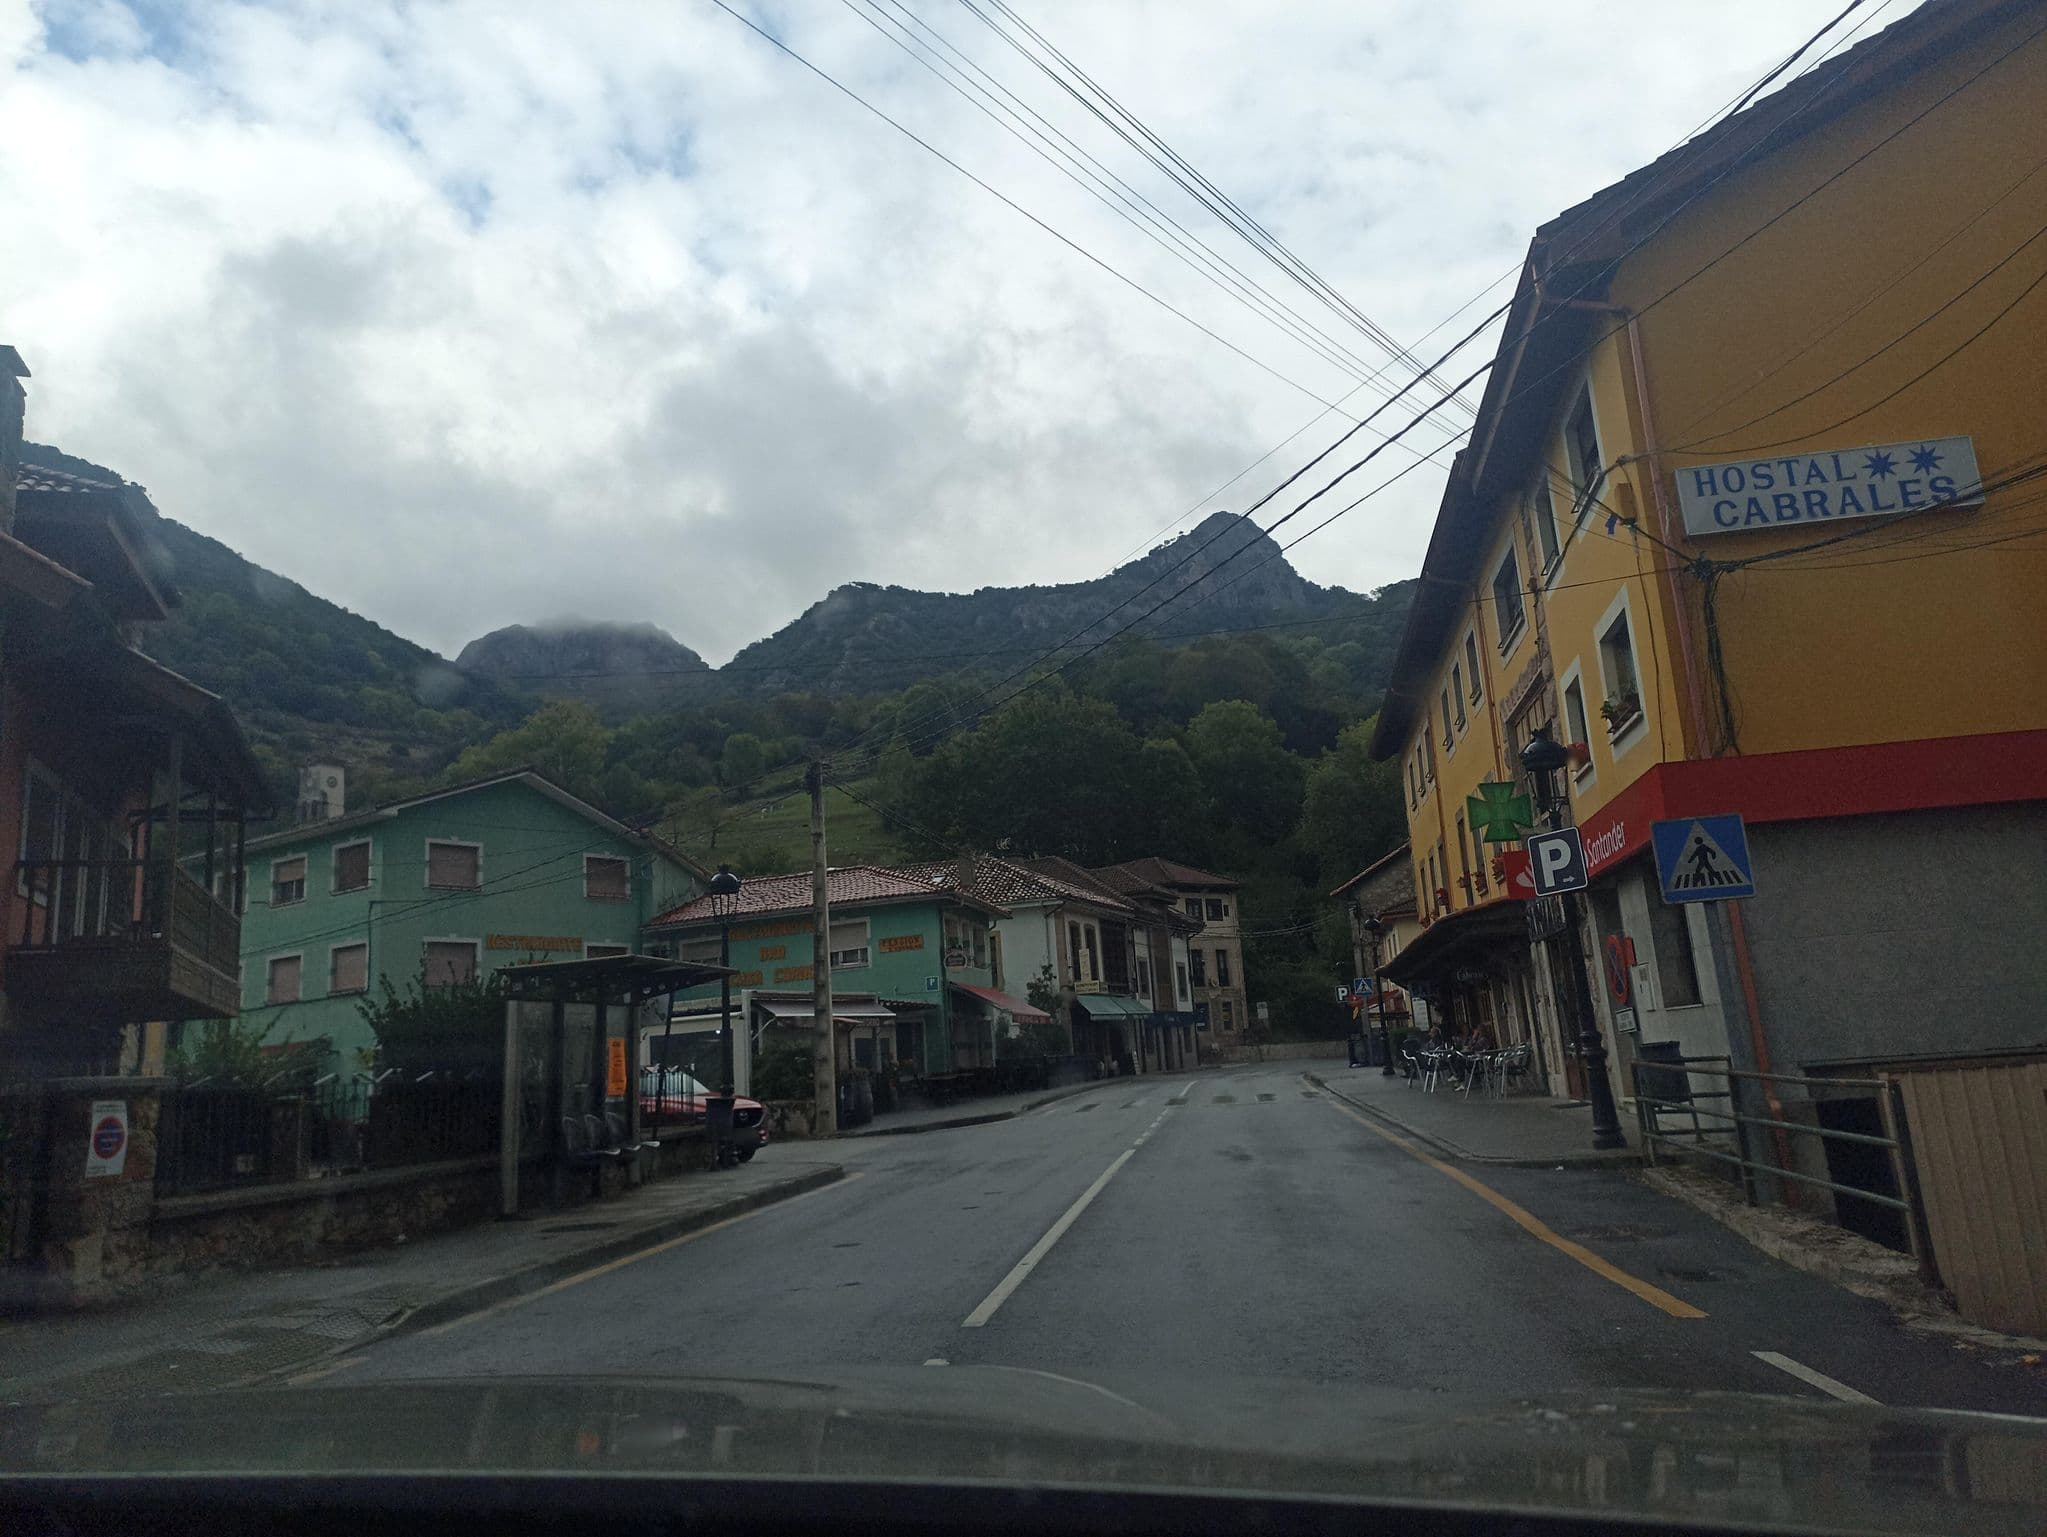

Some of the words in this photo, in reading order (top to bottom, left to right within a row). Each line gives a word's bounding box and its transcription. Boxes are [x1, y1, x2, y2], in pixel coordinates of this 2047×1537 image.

[1693, 454, 1858, 498] HOSTAL
[1712, 475, 1959, 528] CABRALES
[1537, 838, 1572, 889] P
[1586, 819, 1626, 868] Santander
[1337, 987, 1348, 1001] P
